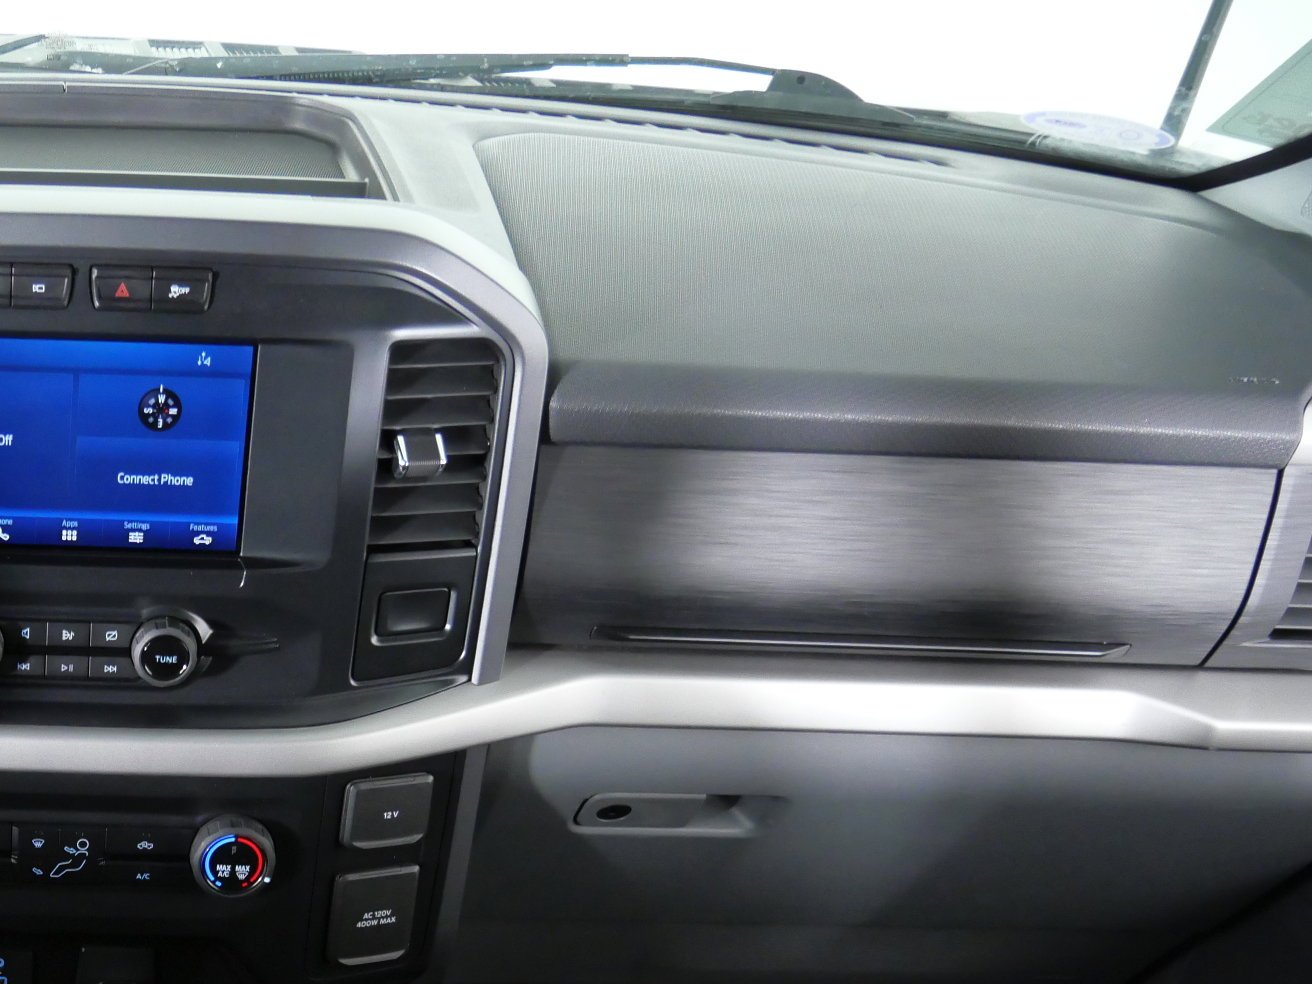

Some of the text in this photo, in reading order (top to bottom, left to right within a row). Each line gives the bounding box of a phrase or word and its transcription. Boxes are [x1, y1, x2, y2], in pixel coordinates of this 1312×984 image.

[178, 286, 190, 295] OFF
[157, 393, 166, 404] W
[117, 471, 194, 486] Connect Phone
[61, 519, 79, 528] Apps
[123, 521, 151, 531] Settings
[189, 523, 218, 532] Features
[154, 655, 178, 664] TUNE
[383, 810, 400, 820] 12 V
[216, 863, 231, 872] MAX
[235, 864, 250, 872] MAX
[135, 872, 151, 880] A/C
[217, 870, 230, 878] A/C
[362, 909, 392, 920] AC 120V
[356, 916, 396, 928] 400W MAX
